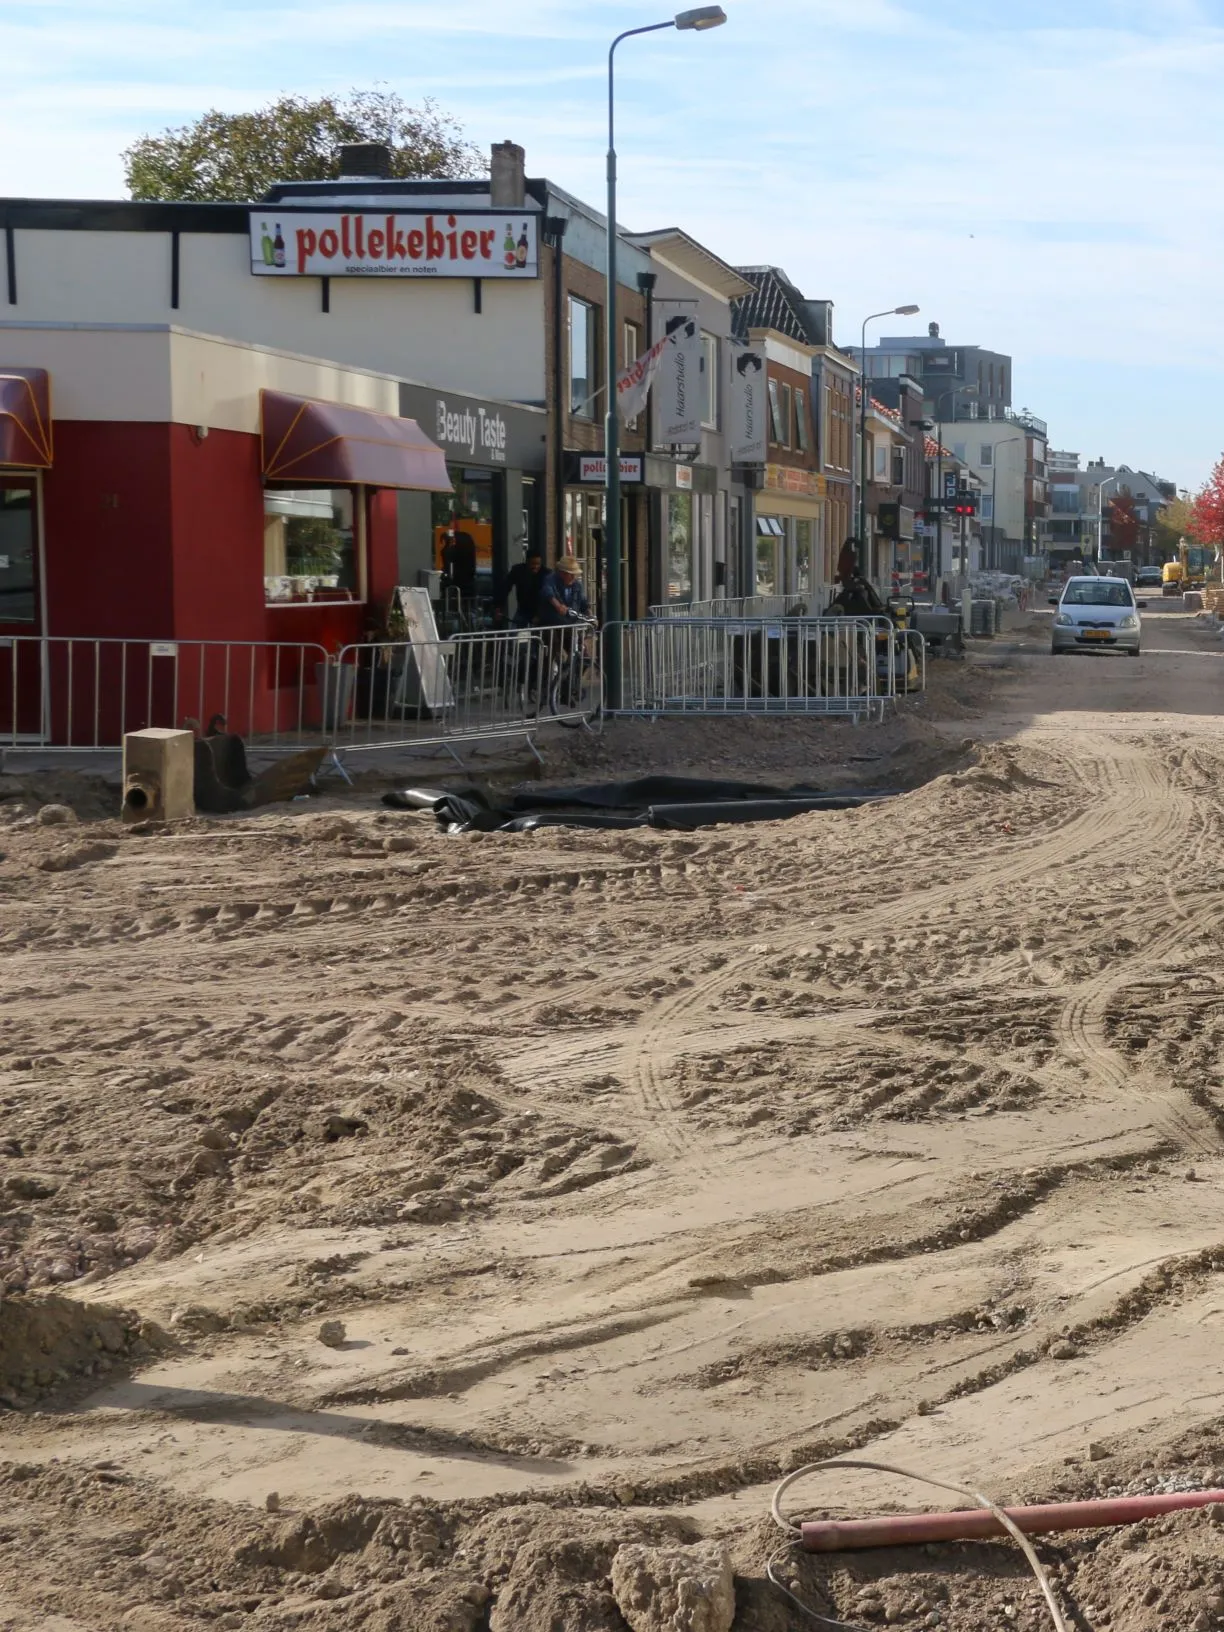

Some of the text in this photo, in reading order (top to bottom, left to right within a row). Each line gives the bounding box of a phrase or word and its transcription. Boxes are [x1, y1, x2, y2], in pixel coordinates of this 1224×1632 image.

[295, 214, 495, 273] pollekebier
[345, 265, 397, 274] speciaalbier
[412, 265, 438, 274] noten
[673, 352, 686, 418] Haarstudio
[437, 400, 477, 455] Beauty
[478, 407, 506, 449] Taste
